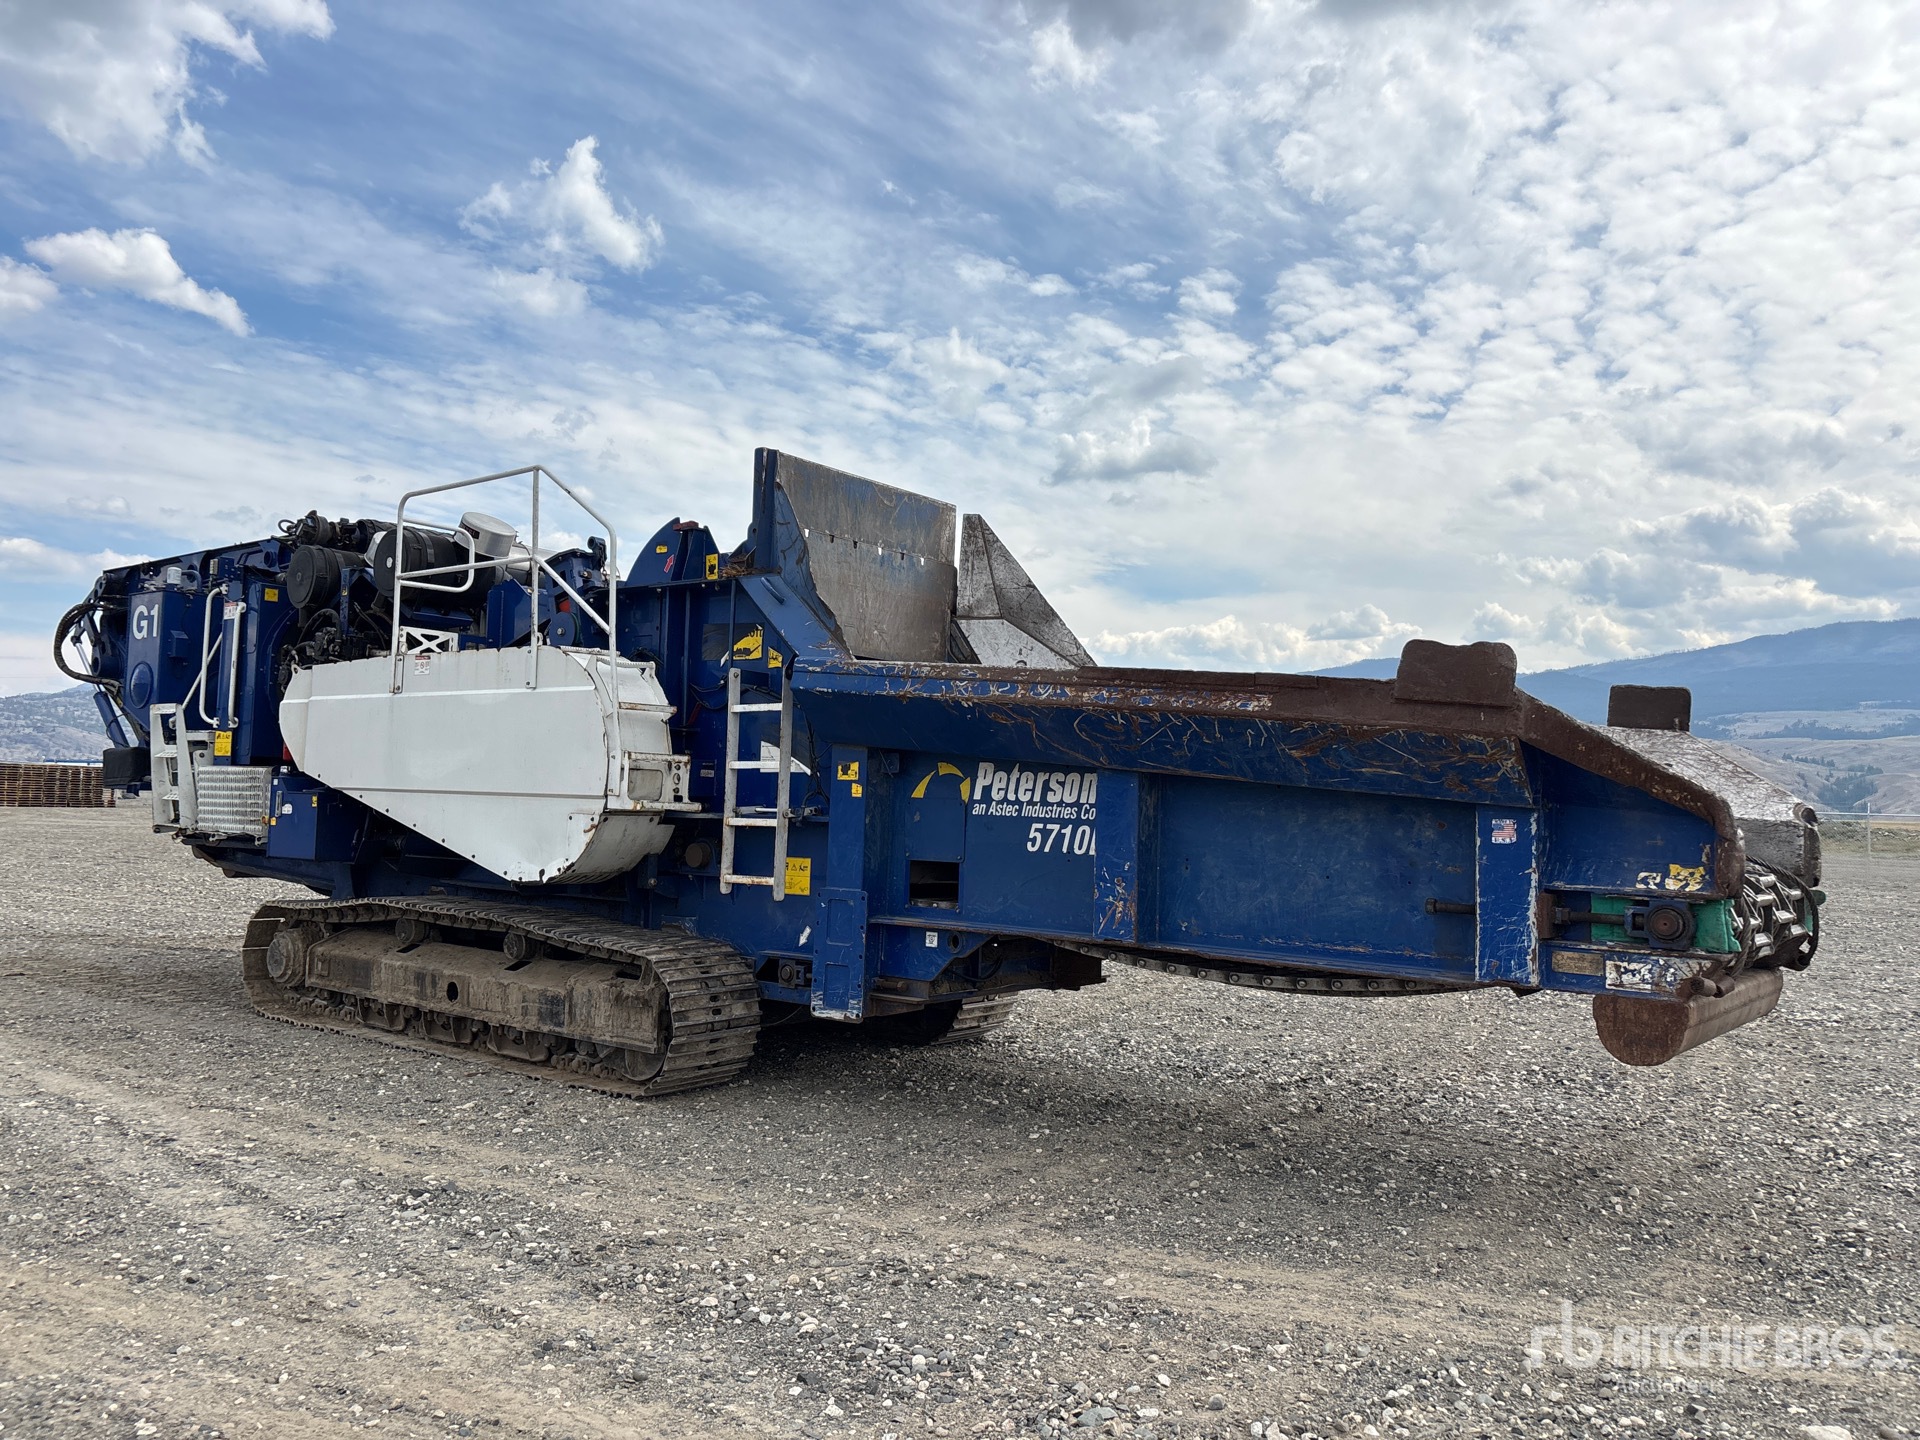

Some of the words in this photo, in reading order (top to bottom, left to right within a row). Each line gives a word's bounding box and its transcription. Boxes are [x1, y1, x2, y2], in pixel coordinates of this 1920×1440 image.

[132, 604, 159, 640] G1
[973, 762, 1098, 804] Peterson
[972, 803, 987, 816] an
[988, 800, 1019, 817] Astec
[1021, 802, 1078, 819] Industries
[1080, 804, 1096, 820] Co
